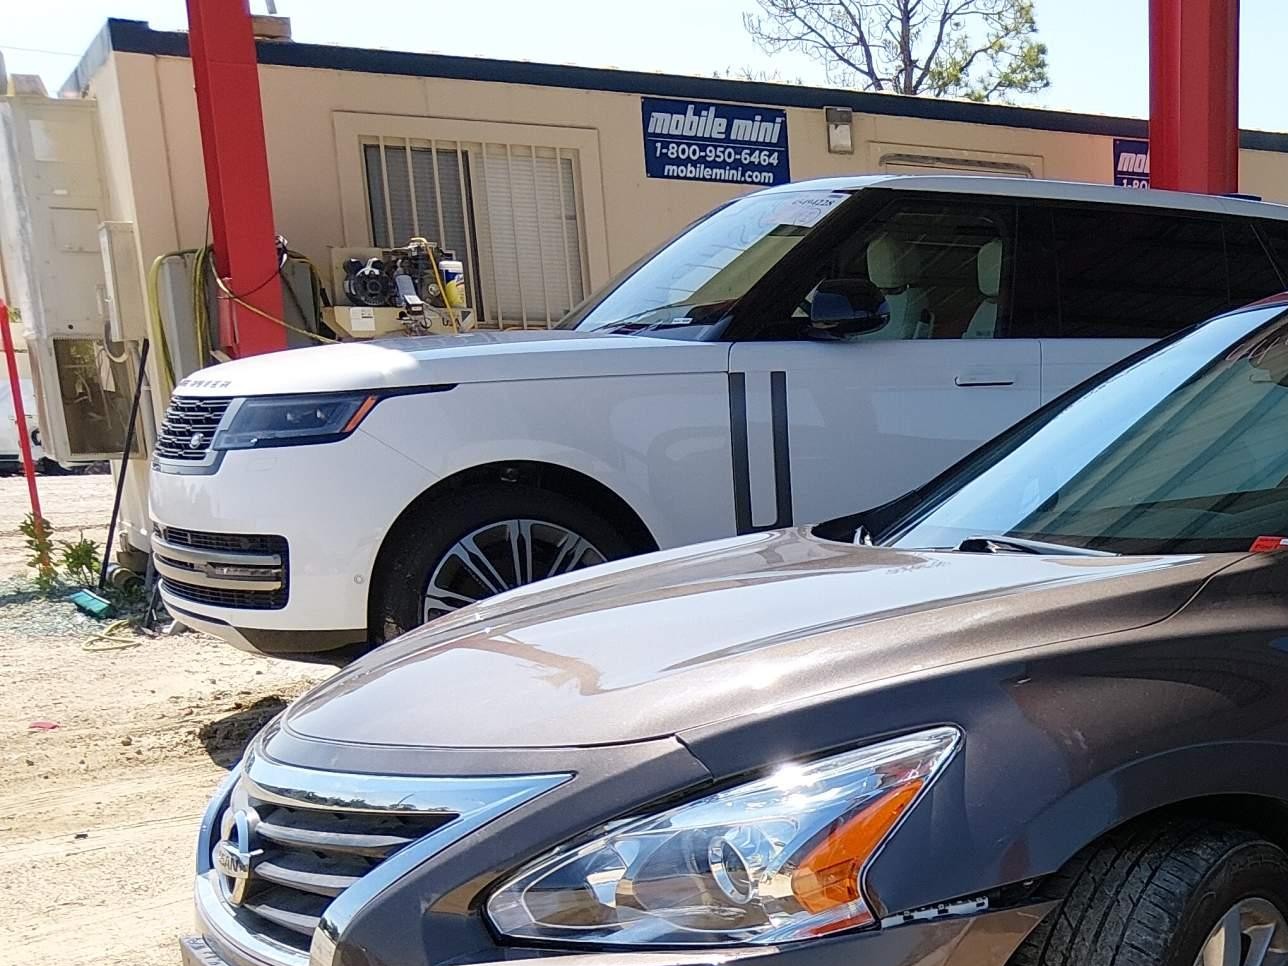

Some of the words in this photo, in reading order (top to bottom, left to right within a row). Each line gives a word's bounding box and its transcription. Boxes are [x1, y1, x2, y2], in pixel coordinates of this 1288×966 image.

[647, 104, 727, 139] mobile
[730, 114, 782, 143] mini
[655, 142, 779, 167] 1-800-950-6464
[664, 163, 774, 184] mobilemini.com
